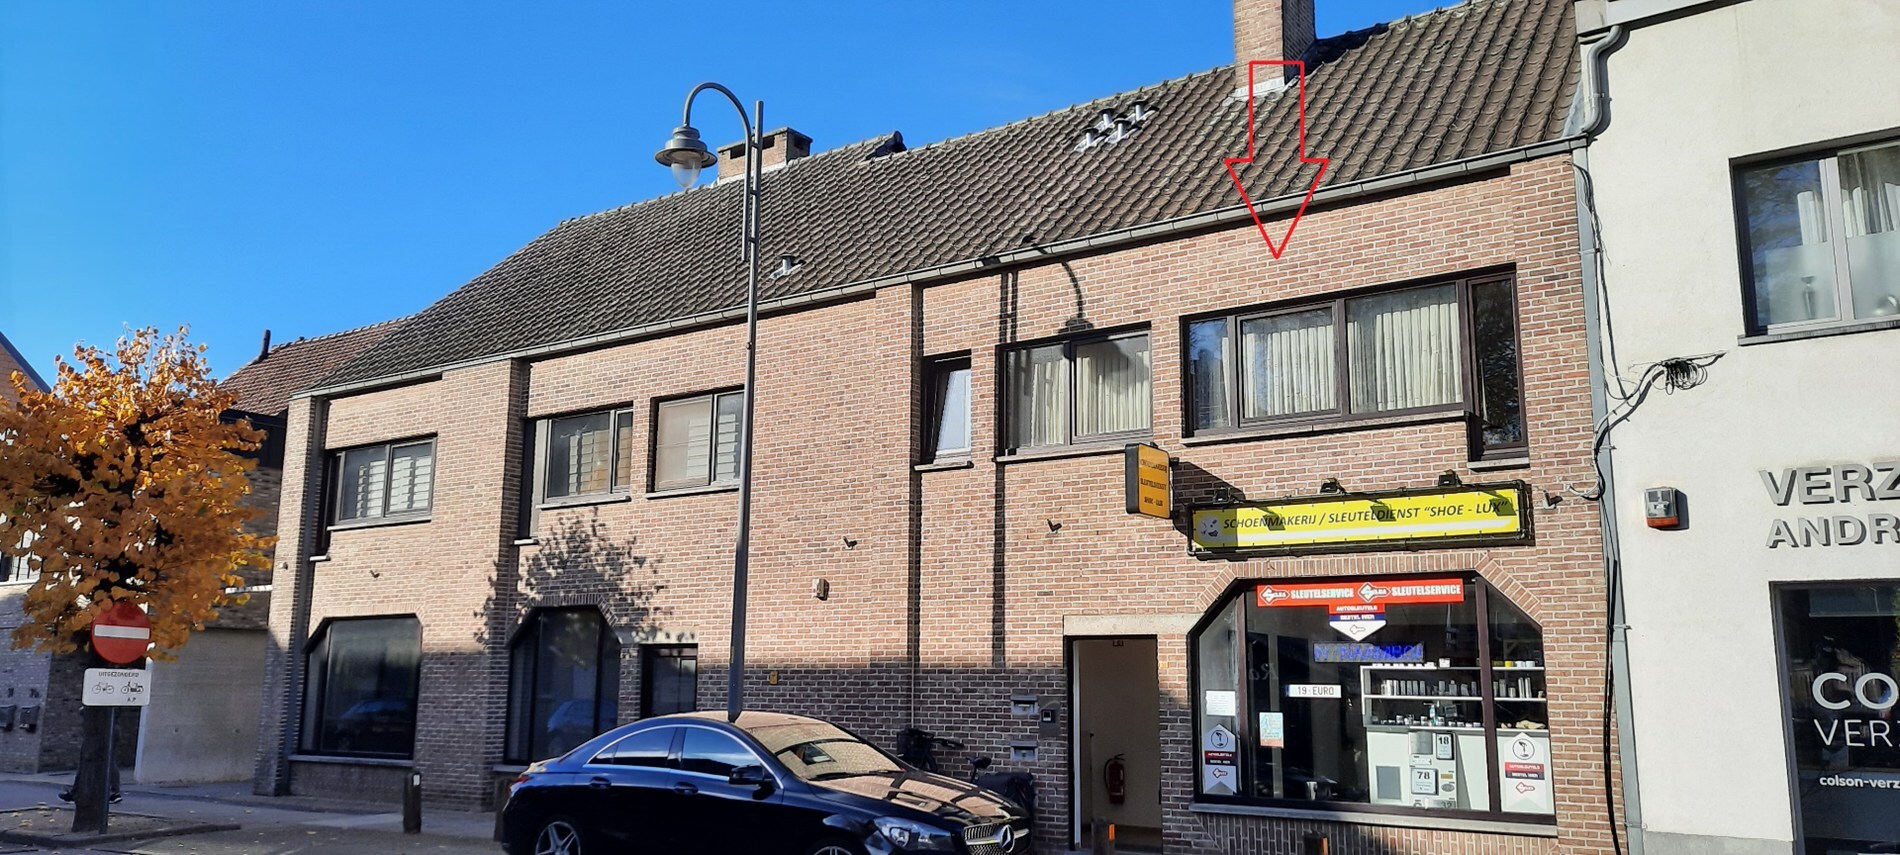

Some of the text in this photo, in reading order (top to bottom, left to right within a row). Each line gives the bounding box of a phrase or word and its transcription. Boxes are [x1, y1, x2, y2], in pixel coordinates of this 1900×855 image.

[1223, 514, 1316, 529] SCHOENMAKERIJ
[1319, 513, 1326, 526] /
[1328, 507, 1420, 523] SLEUTELDIENST
[1291, 588, 1354, 599] SLEUTELSERVICE
[1391, 584, 1461, 596] SLEUTELSERVICE
[1812, 672, 1899, 710] CO
[1438, 736, 1449, 745] 18
[1416, 771, 1430, 780] 78
